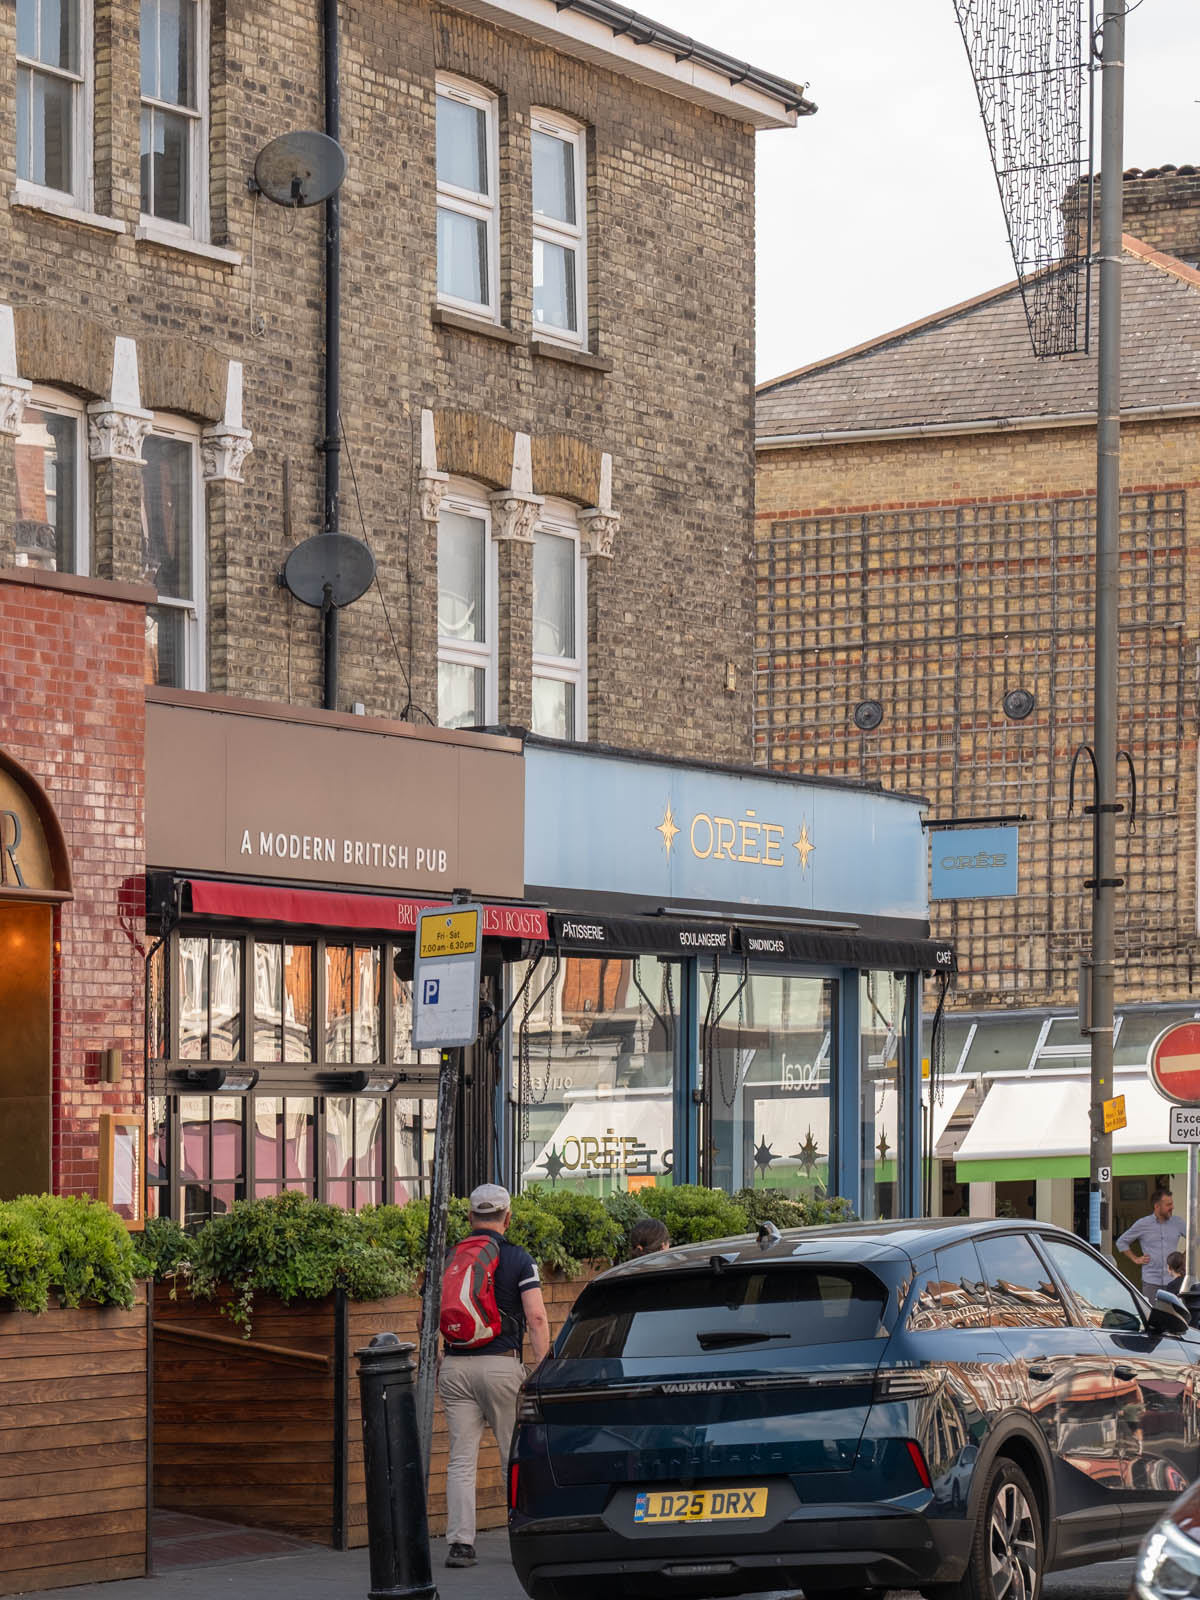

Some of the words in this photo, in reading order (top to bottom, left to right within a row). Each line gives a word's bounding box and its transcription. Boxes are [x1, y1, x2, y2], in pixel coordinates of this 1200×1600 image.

[240, 830, 252, 855] A
[260, 831, 336, 862] MODERN
[343, 839, 408, 869] BRITISH
[416, 847, 448, 873] PUB
[449, 931, 460, 939] Sat
[679, 932, 726, 947] BOULANGERIE
[1177, 1126, 1200, 1138] cycl
[1102, 1168, 1109, 1180] 9
[661, 1381, 735, 1393] VAUXHALL
[644, 1495, 705, 1518] LD25
[710, 1491, 757, 1515] DRX
